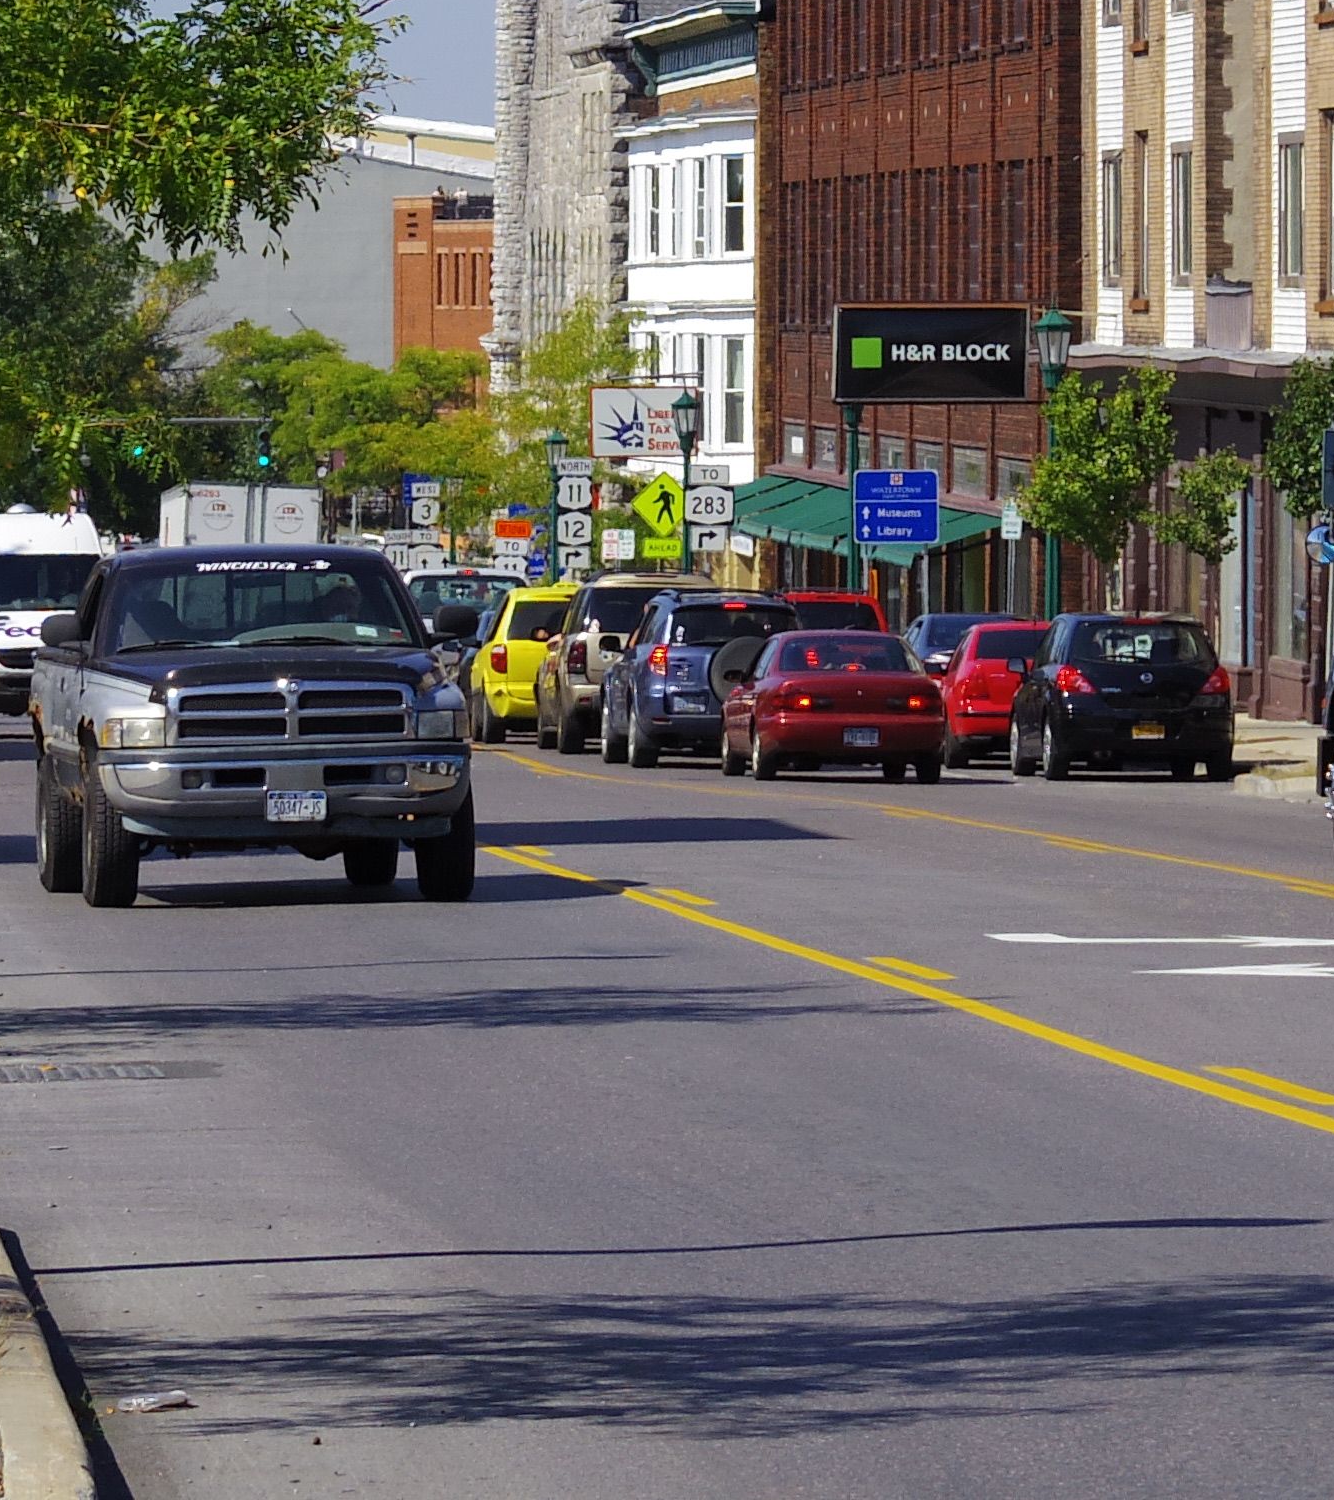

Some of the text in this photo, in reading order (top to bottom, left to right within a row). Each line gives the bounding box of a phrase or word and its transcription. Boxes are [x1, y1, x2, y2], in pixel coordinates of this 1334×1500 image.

[891, 344, 1011, 361] H&R BLOCK
[560, 460, 590, 471] NORTH
[701, 469, 718, 480] TO
[568, 484, 582, 502] 11
[692, 497, 726, 514] 283
[421, 504, 432, 520] 3
[877, 508, 922, 518] Museums
[564, 520, 585, 538] 12
[877, 525, 913, 537] Library
[420, 533, 432, 541] TO
[504, 541, 520, 550] TO
[649, 544, 677, 552] AHEAD
[392, 551, 404, 566] 11
